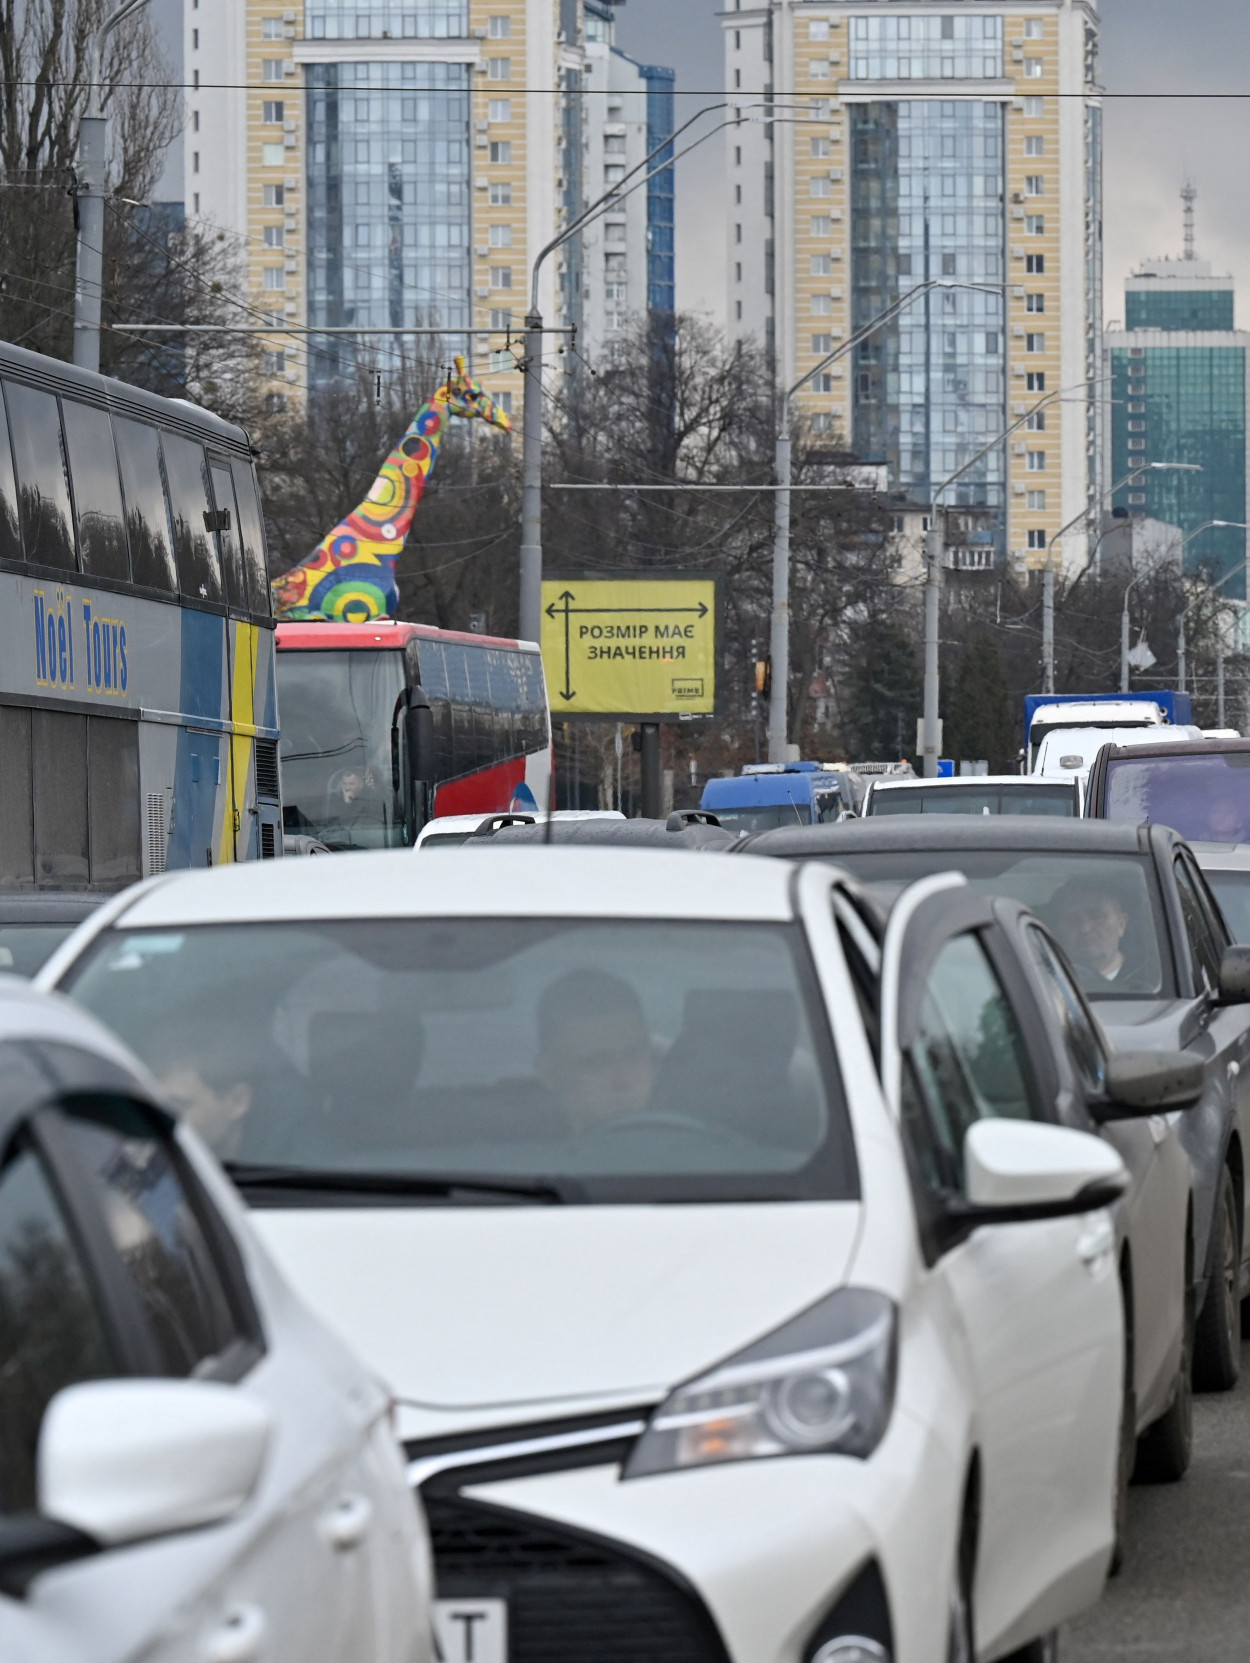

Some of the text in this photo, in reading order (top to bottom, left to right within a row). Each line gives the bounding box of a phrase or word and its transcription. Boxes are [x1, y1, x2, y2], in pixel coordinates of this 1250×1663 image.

[579, 624, 695, 639] РОЗМІР МАЄ
[33, 586, 128, 698] Noël Tours
[587, 645, 686, 660] ЗНАЧЕННЯ
